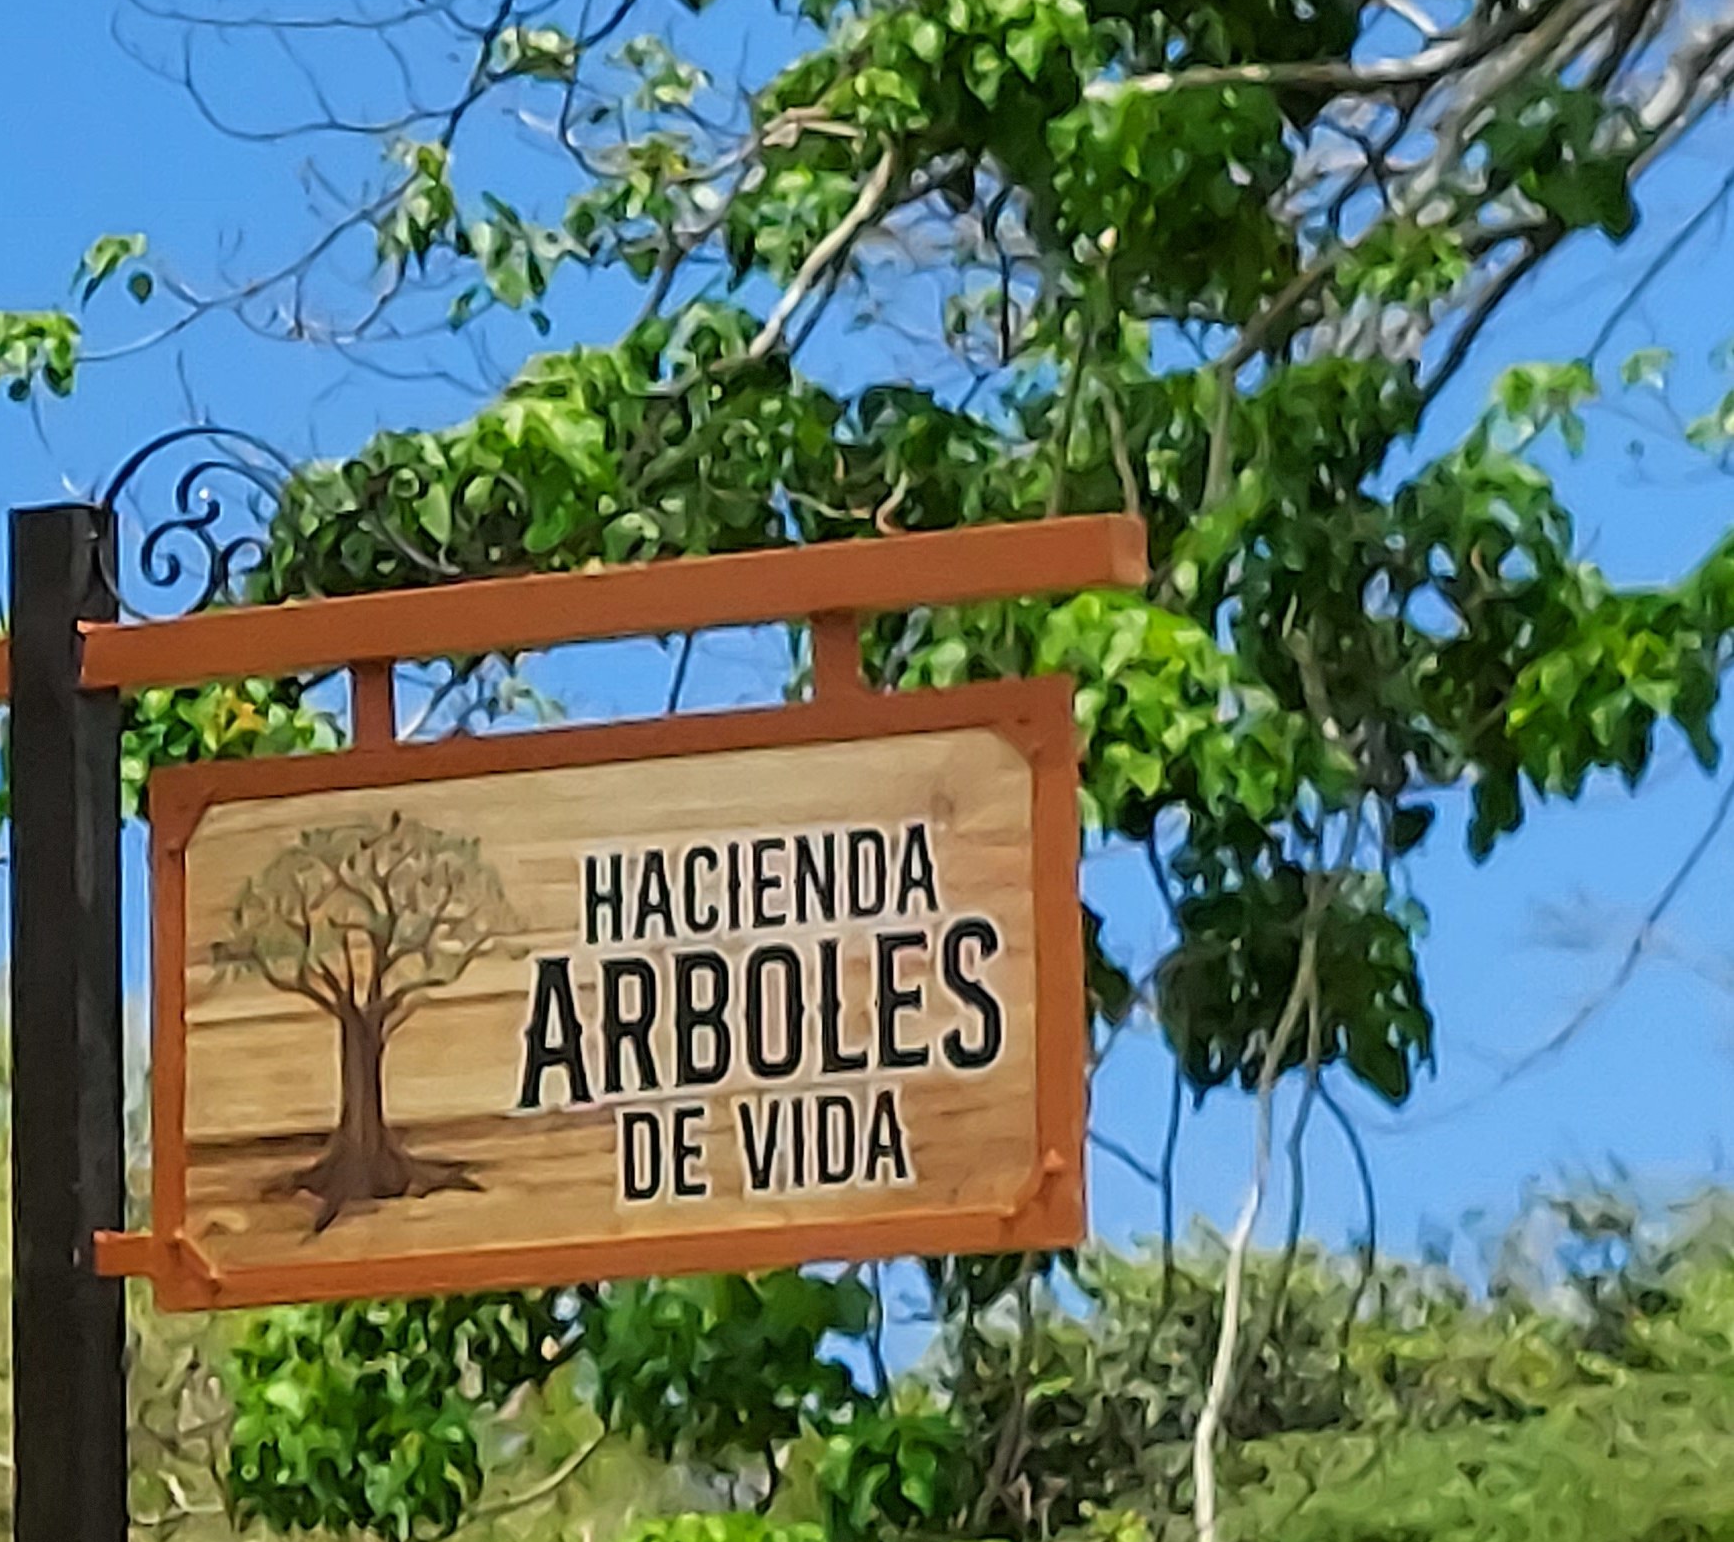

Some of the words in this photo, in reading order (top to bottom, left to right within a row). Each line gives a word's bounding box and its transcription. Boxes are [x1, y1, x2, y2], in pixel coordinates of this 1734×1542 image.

[585, 824, 938, 943] HACIENDA
[519, 919, 1002, 1107] ARBOLES
[623, 1108, 706, 1200] DE
[739, 1091, 908, 1189] VIDA
